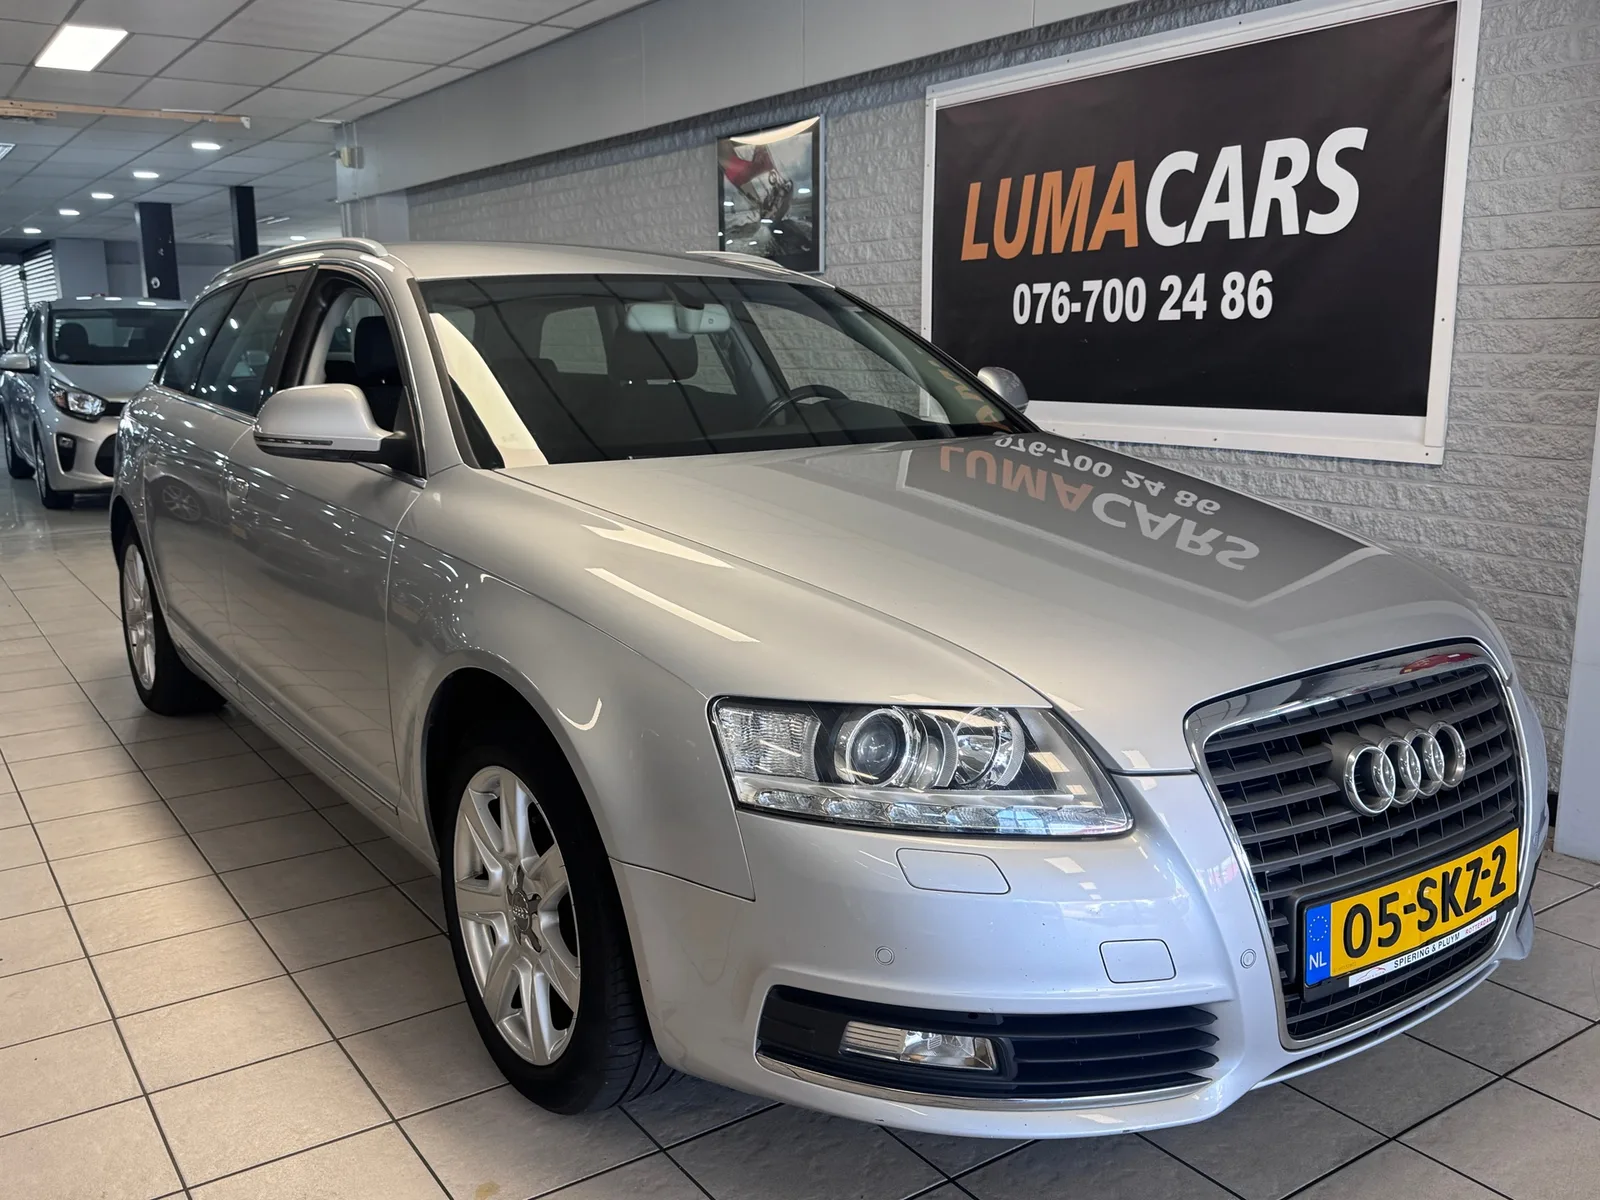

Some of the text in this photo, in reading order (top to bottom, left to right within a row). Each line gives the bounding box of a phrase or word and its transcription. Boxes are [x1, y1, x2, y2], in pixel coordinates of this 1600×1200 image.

[961, 126, 1369, 261] LUMACARS
[1012, 269, 1273, 325] 076-700 24 86
[1343, 845, 1507, 958] 05-SKZ-2
[1309, 951, 1327, 971] NL
[1393, 915, 1493, 969] SPIERING & PLUYM ROTTERDAM
